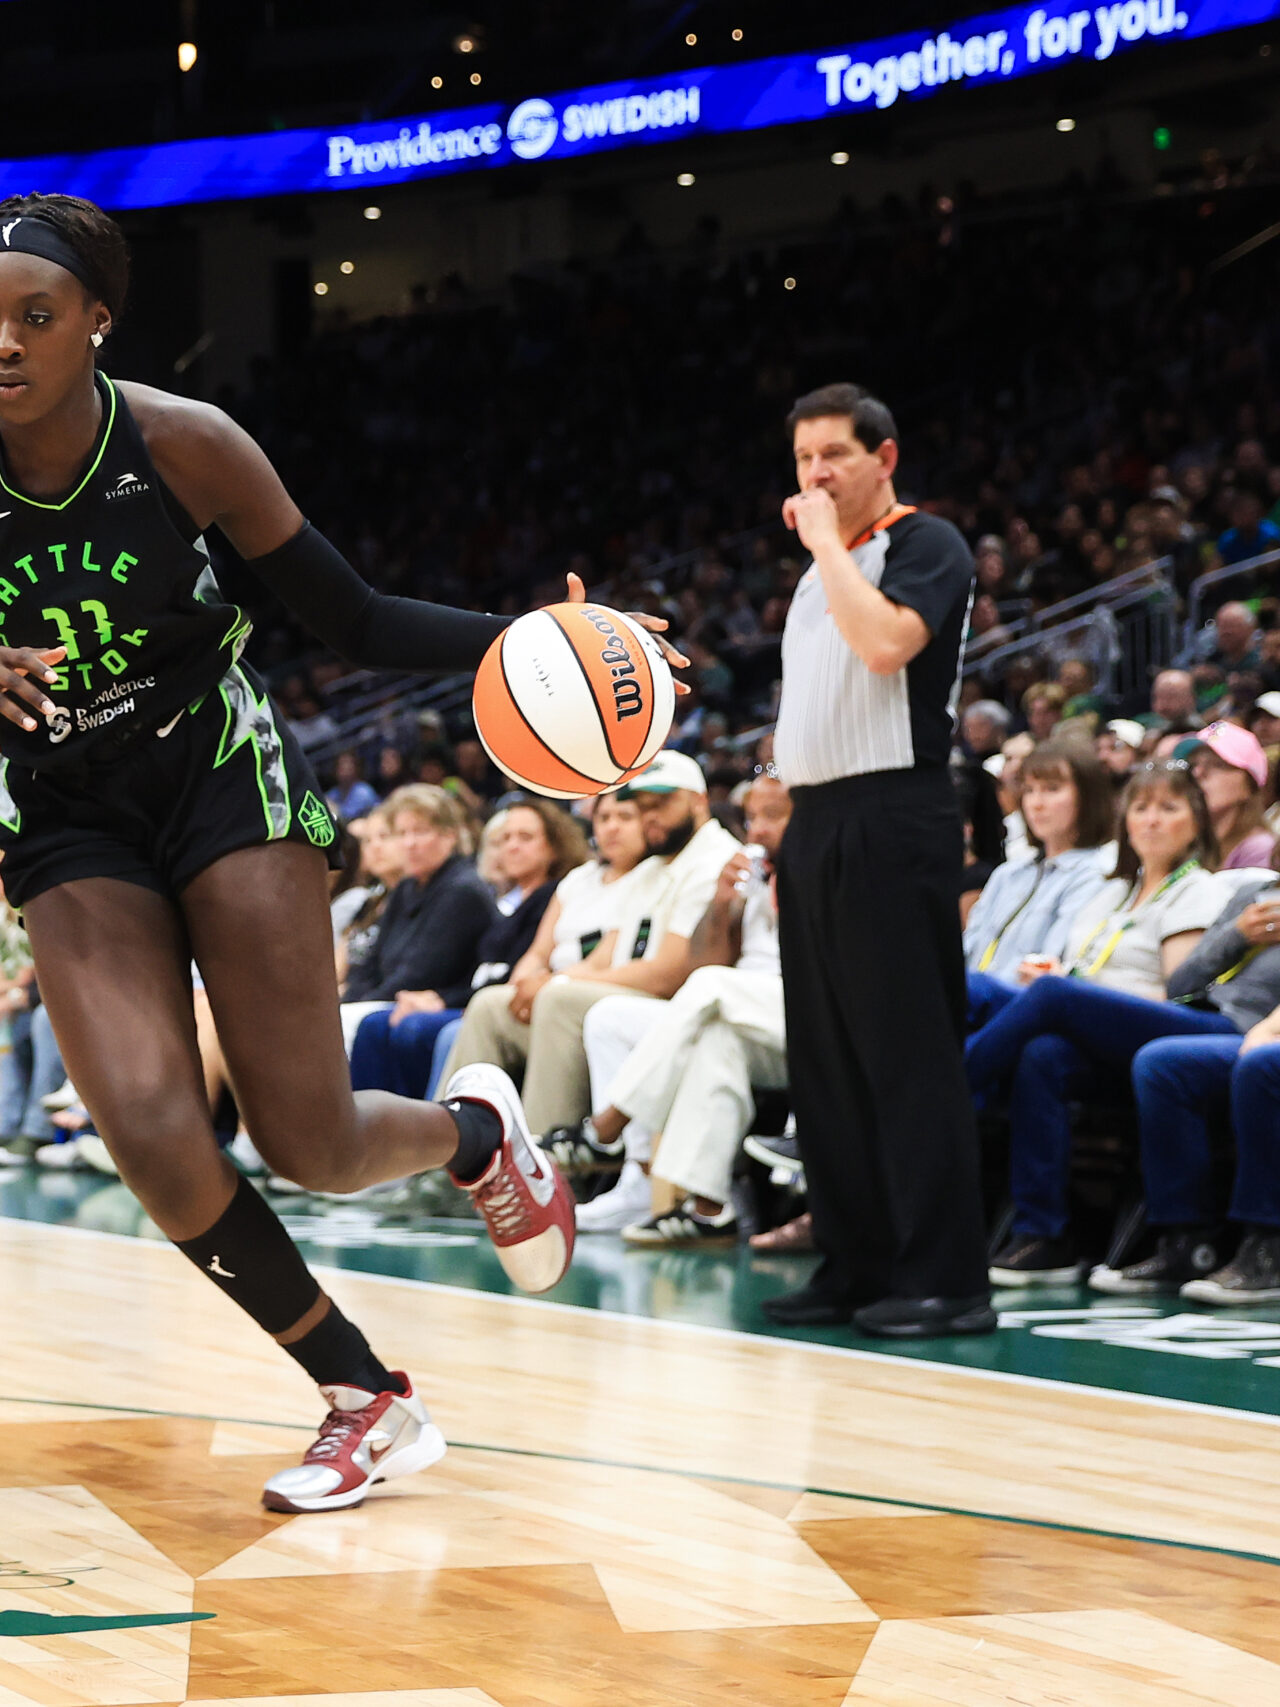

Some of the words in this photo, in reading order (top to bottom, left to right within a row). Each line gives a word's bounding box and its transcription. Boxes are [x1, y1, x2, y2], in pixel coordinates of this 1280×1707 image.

[817, 31, 1016, 109] Together,
[1024, 9, 1091, 63] for
[1094, 0, 1188, 61] you.
[325, 121, 503, 177] Providence
[562, 85, 701, 142] SWEDISH
[105, 483, 150, 500] SYMETRA
[579, 608, 644, 723] Wilson
[76, 697, 135, 733] SWEDISH
